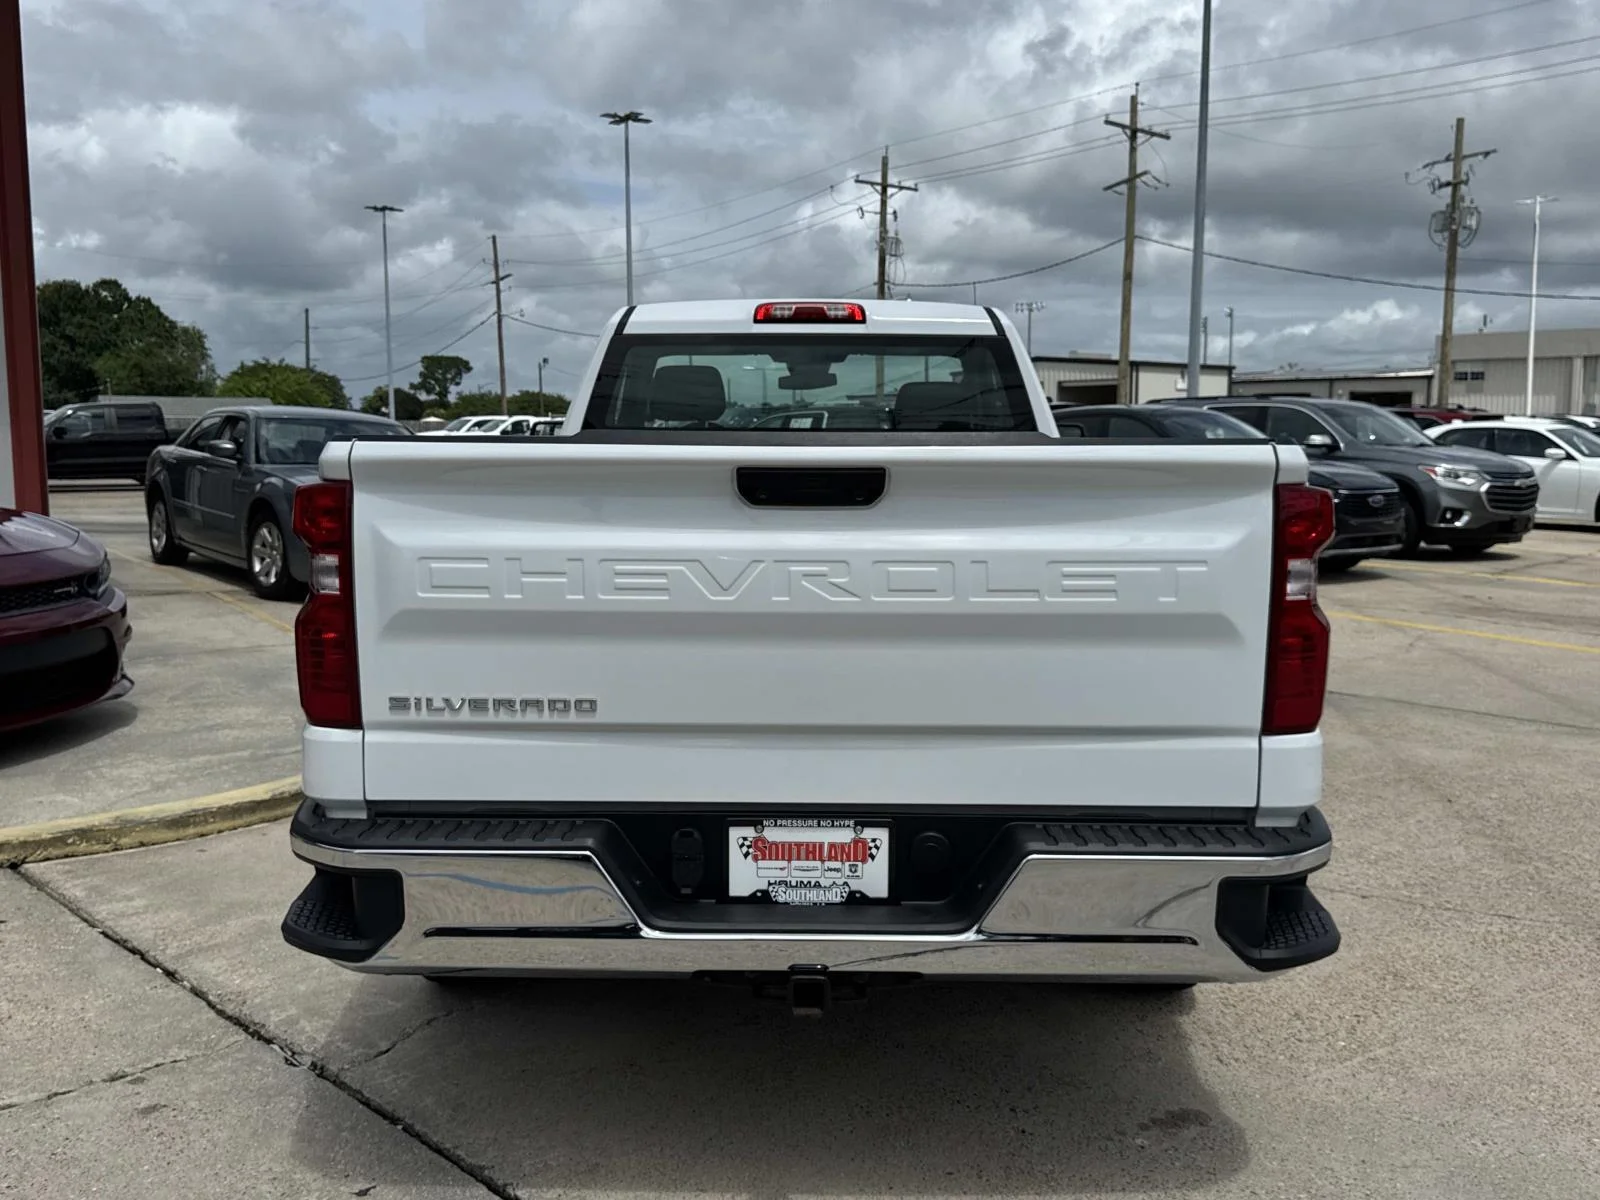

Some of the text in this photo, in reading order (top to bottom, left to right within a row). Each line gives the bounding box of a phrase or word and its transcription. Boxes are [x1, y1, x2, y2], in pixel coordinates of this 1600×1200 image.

[415, 557, 1209, 602] CHEVROLET
[388, 697, 597, 712] SILVERADO
[834, 820, 855, 828] HYPE
[752, 837, 868, 863] SOUTHLAND
[778, 886, 841, 902] SOUTHLAND
